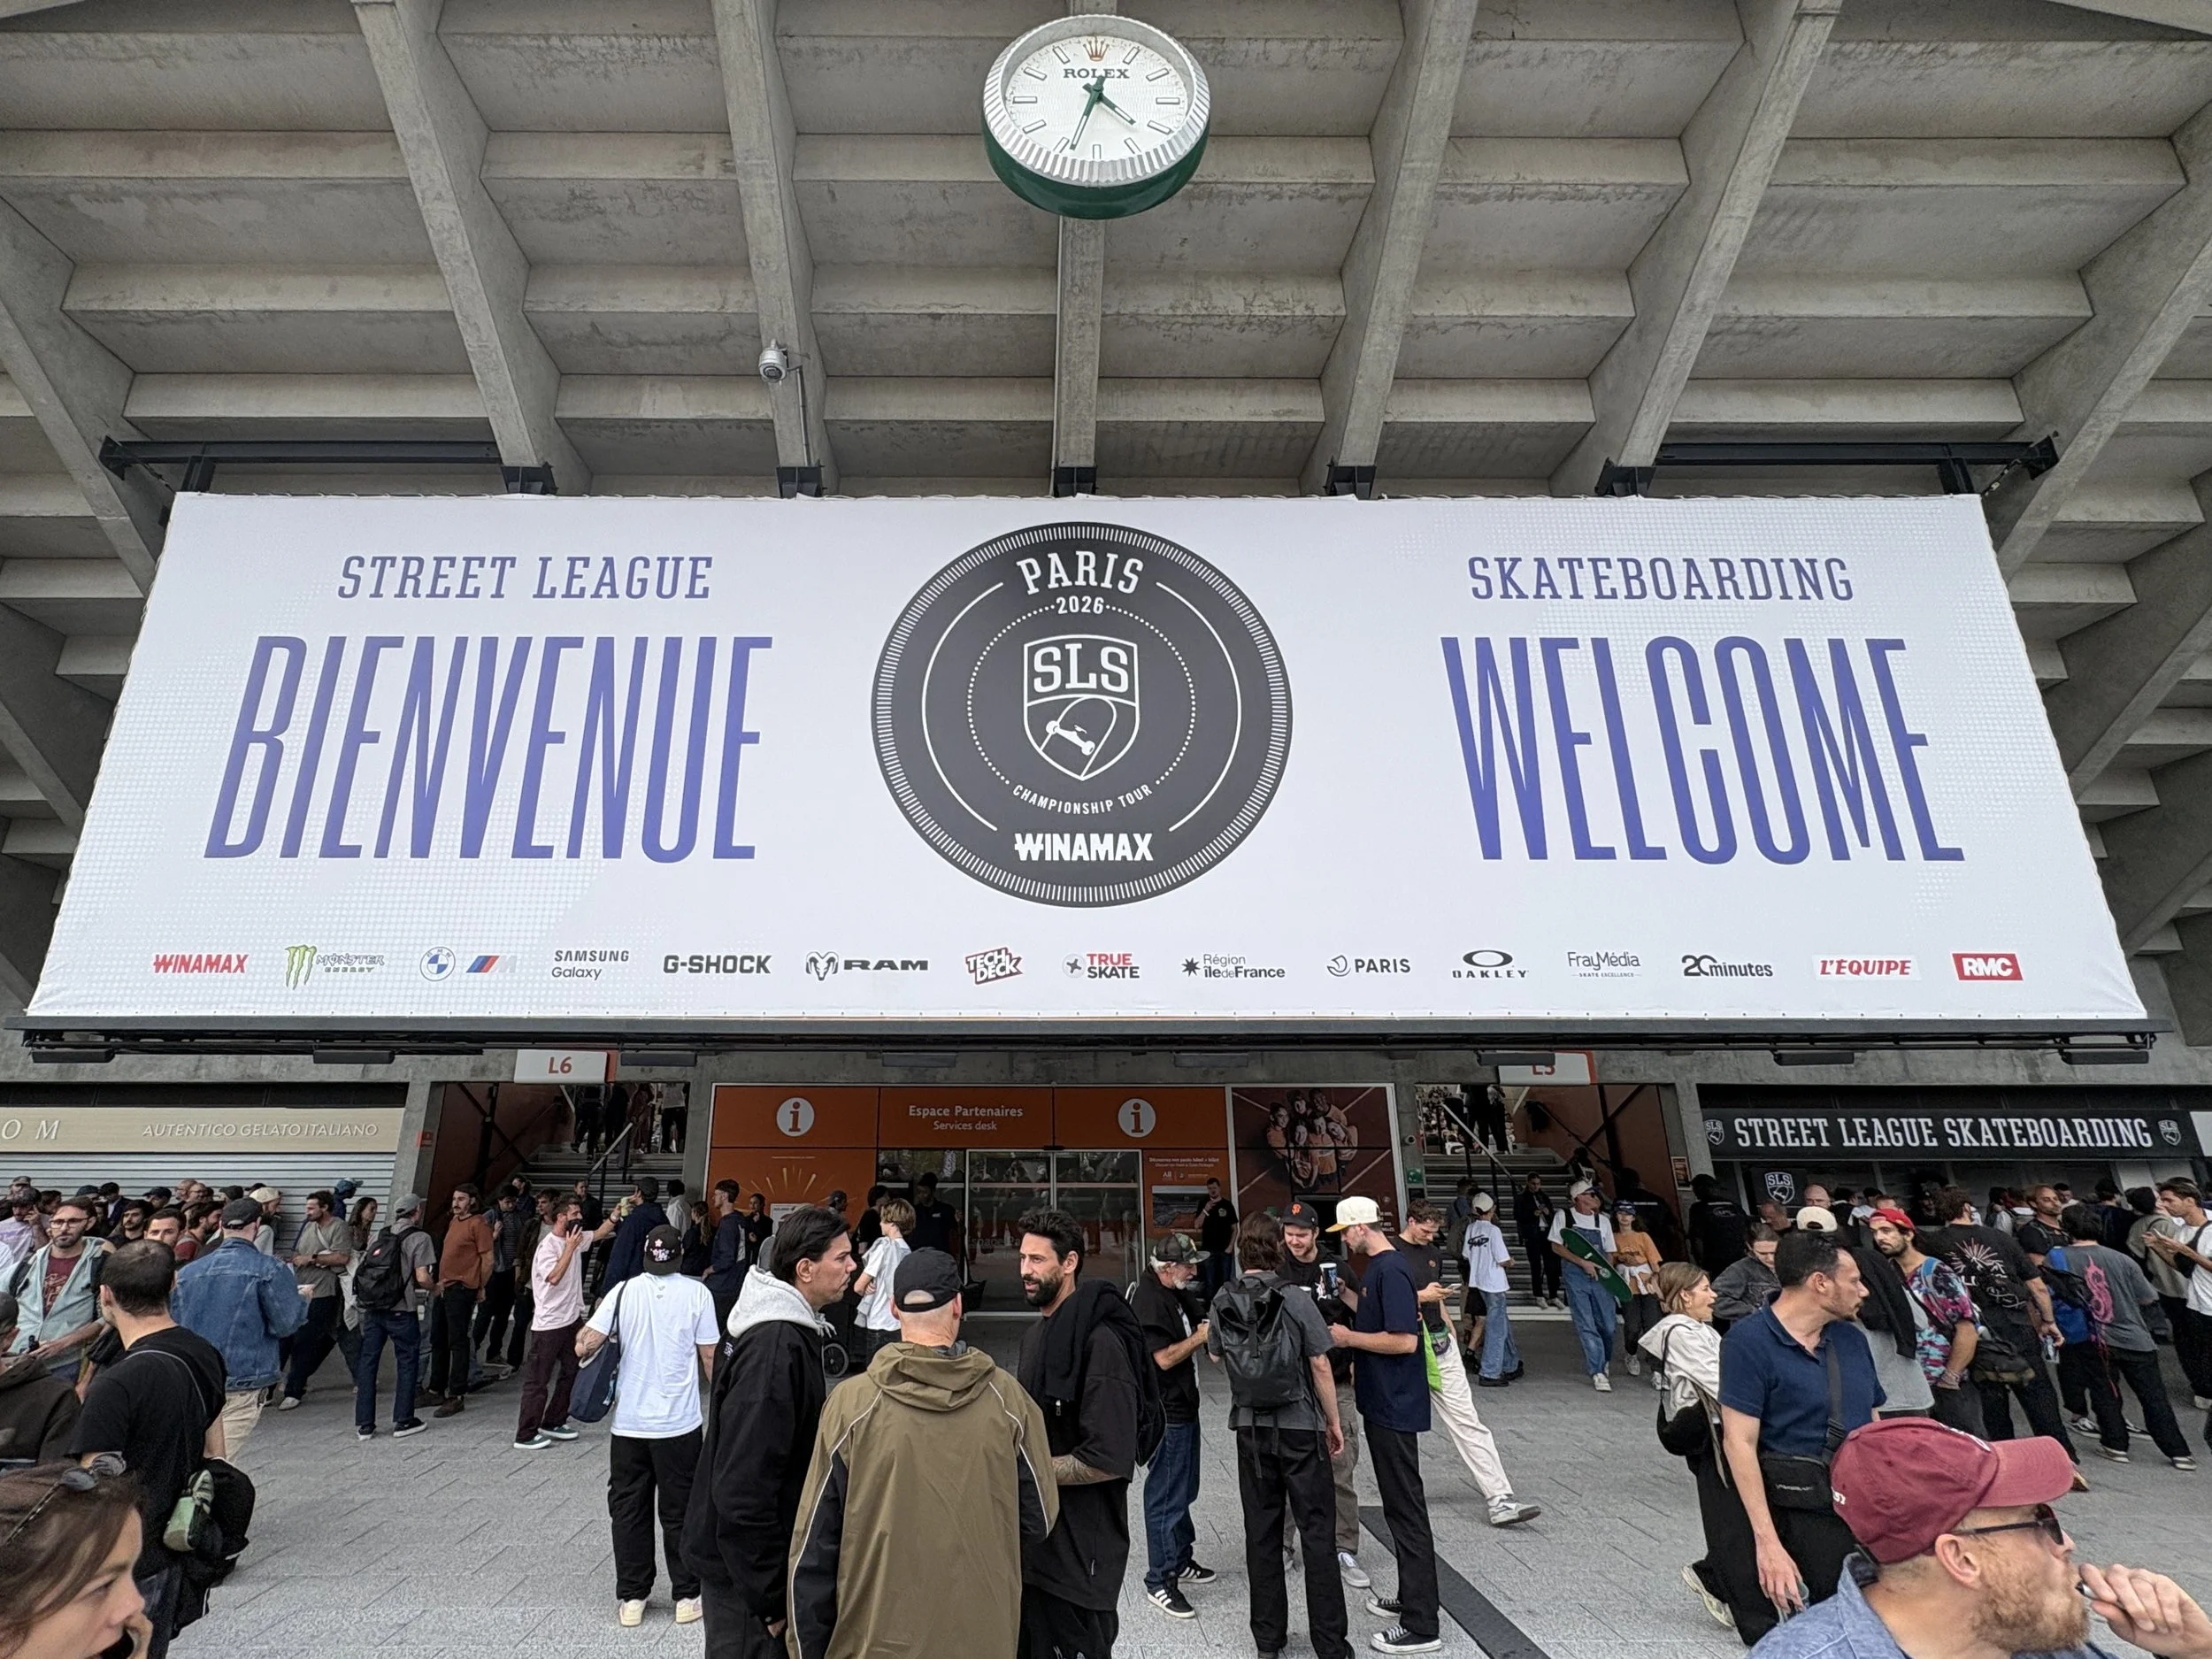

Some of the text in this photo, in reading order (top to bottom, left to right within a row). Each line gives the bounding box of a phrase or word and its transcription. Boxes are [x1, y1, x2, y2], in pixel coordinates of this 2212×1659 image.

[1064, 68, 1129, 79] ROLEX
[338, 556, 712, 599] STREET LEAGUE
[1017, 550, 1144, 595] PARIS
[1468, 557, 1855, 602] SKATEBOARDING
[1056, 595, 1104, 614] 2026
[1033, 642, 1129, 693] SLS
[204, 635, 772, 864] BIENVENUE
[1440, 636, 1965, 864] WELCOME
[1013, 784, 1152, 815] CHAMPIONSHIP TOUR
[1014, 833, 1154, 861] WINAMAX
[153, 954, 249, 973] WINAMAX
[316, 953, 385, 966] MONSTER
[554, 950, 629, 962] SAMSUNG
[664, 955, 772, 974] G-SHOCK
[967, 949, 1006, 972] TECH
[1087, 953, 1133, 965] TRUE
[1203, 953, 1246, 966] Région
[1567, 951, 1640, 971] FrayMédia
[551, 966, 602, 980] Galaxy
[843, 959, 929, 972] RAM
[976, 952, 1018, 983] DECK
[1087, 966, 1141, 979] SKATE
[1355, 958, 1411, 973] PARIS
[1452, 970, 1527, 979] OAKLEY
[1962, 957, 2013, 977] RMC
[549, 1056, 572, 1074] L6
[909, 1105, 1024, 1118] Espace Partenaires
[142, 1123, 379, 1137] AUTENTICO GELATO ITALIANO
[933, 1120, 997, 1131] Services desk
[1705, 1121, 1722, 1131] SLS
[1734, 1118, 2154, 1148] STREET LEAGUE SKATEBOARDING
[2160, 1121, 2177, 1131] SLS
[1768, 1174, 1791, 1186] SLS
